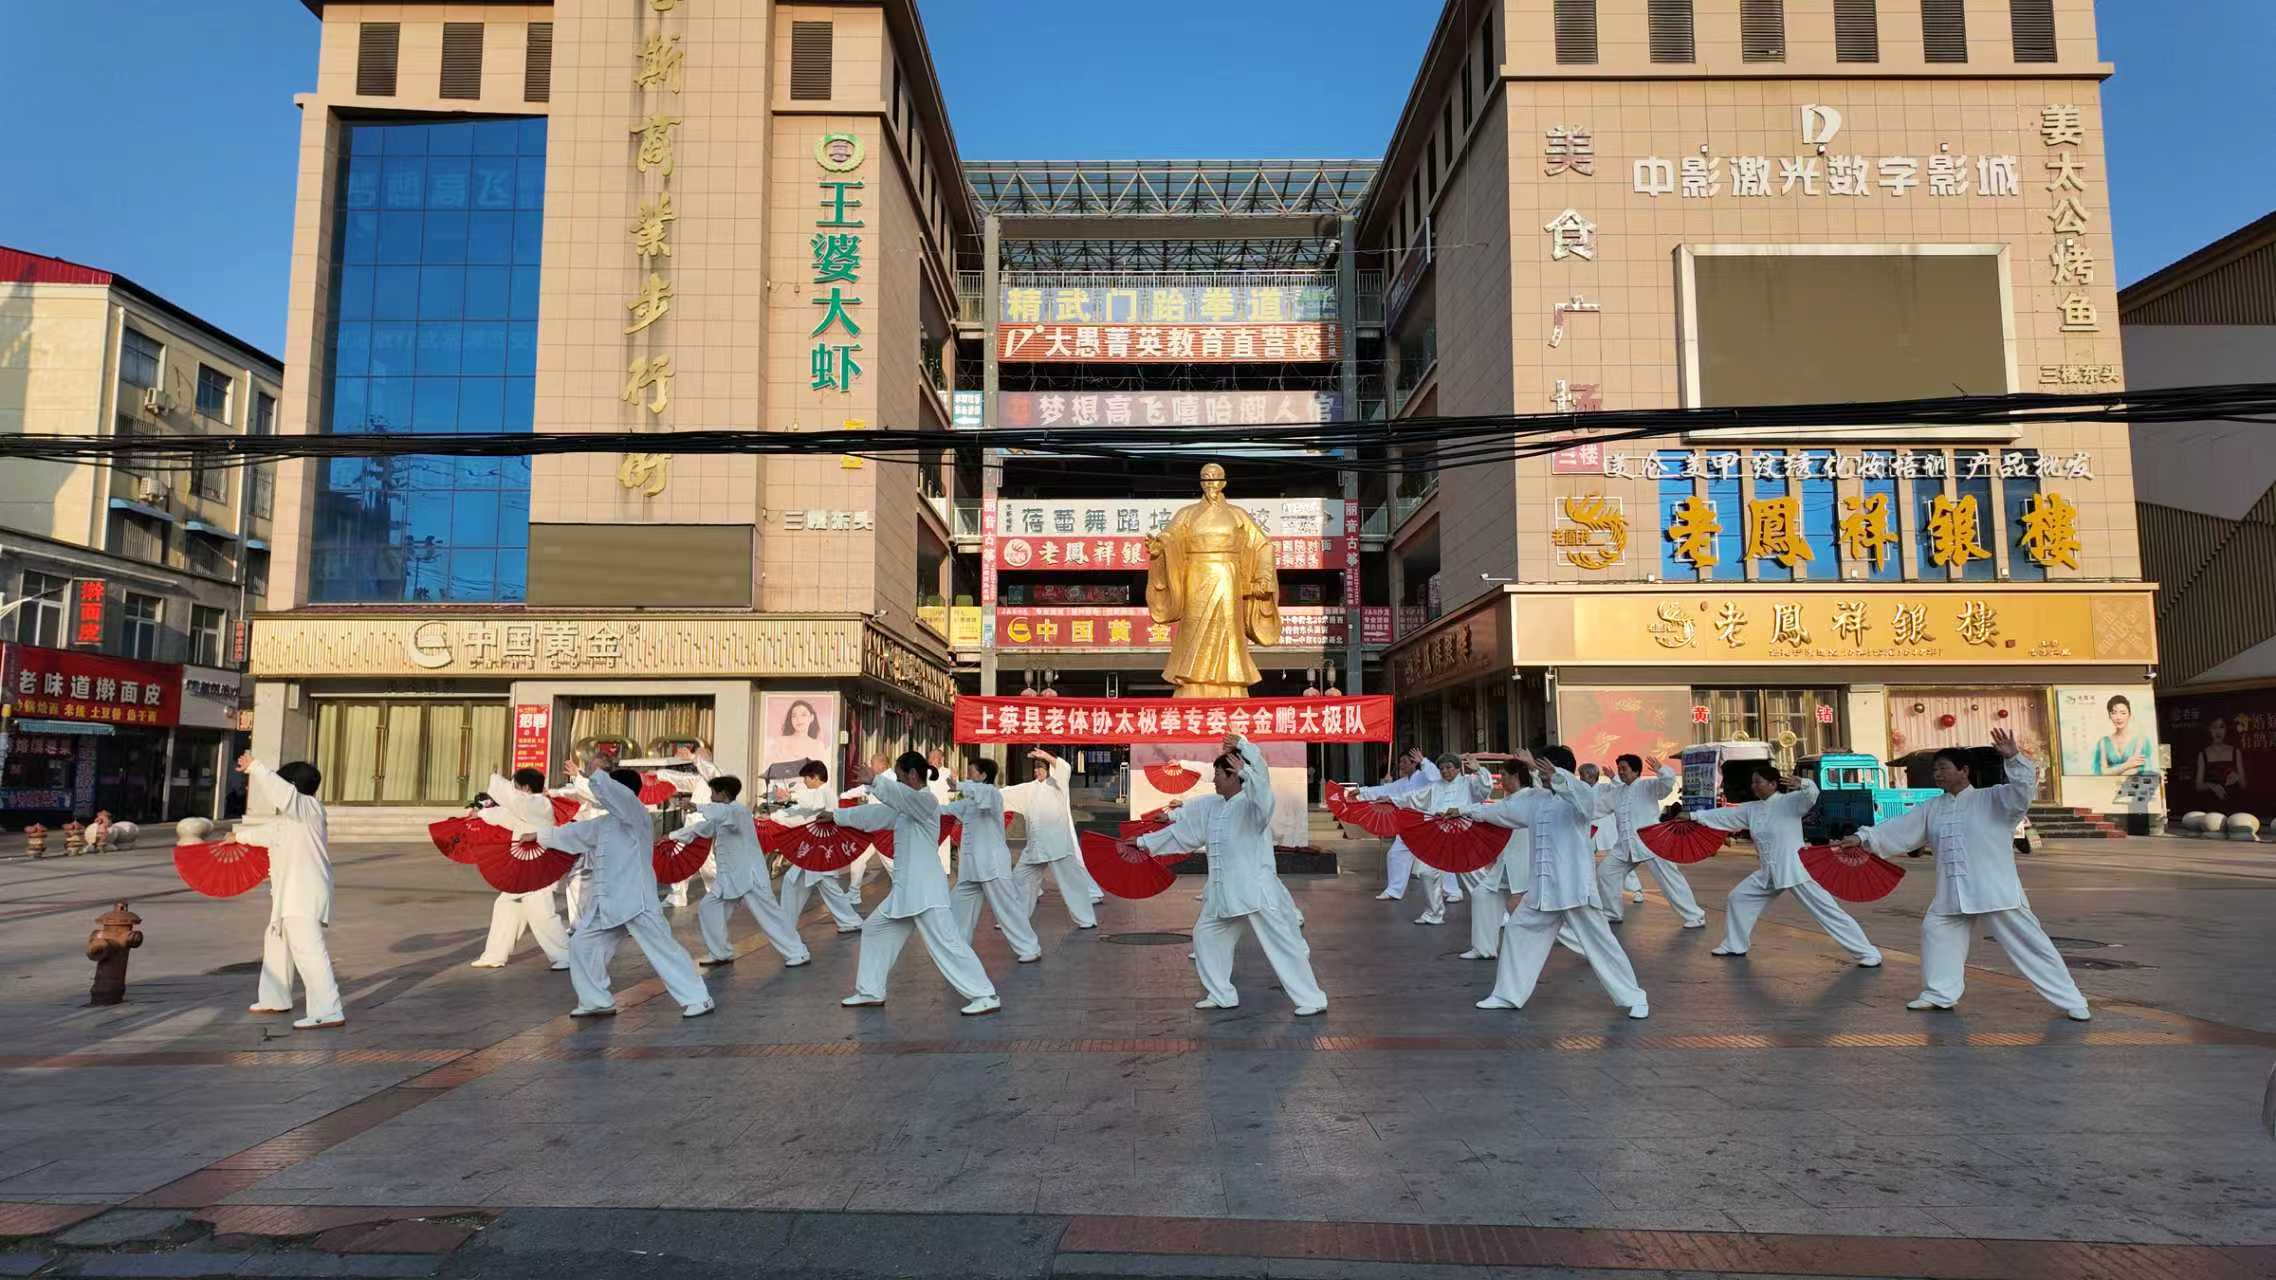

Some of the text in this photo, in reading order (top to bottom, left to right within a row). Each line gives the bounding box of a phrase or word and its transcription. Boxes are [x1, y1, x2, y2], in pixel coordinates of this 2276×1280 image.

[1633, 154, 2019, 198] 中影激光数字影城
[2040, 103, 2099, 332] 姜太公烤鱼
[617, 0, 684, 496] 斯商業步行街
[810, 180, 864, 392] 王婆大虾
[1544, 123, 1603, 433] 美食广场
[1045, 325, 1322, 358] 大愚菁英教育直营校
[1022, 507, 1271, 533] 蓓蕾舞蹈培校
[1668, 491, 2081, 572] 老鳳祥銀樓
[1038, 540, 1146, 566] 老鳳祥銀
[464, 621, 624, 658] 中国黄金
[1036, 617, 1171, 643] 中国黄金
[1714, 600, 2001, 648] 老鳳祥銀樓
[519, 713, 548, 736] 招聘
[975, 705, 1366, 737] 上蔡县老体协太极拳专委会金鹏太极队
[1692, 705, 1710, 723] 黄
